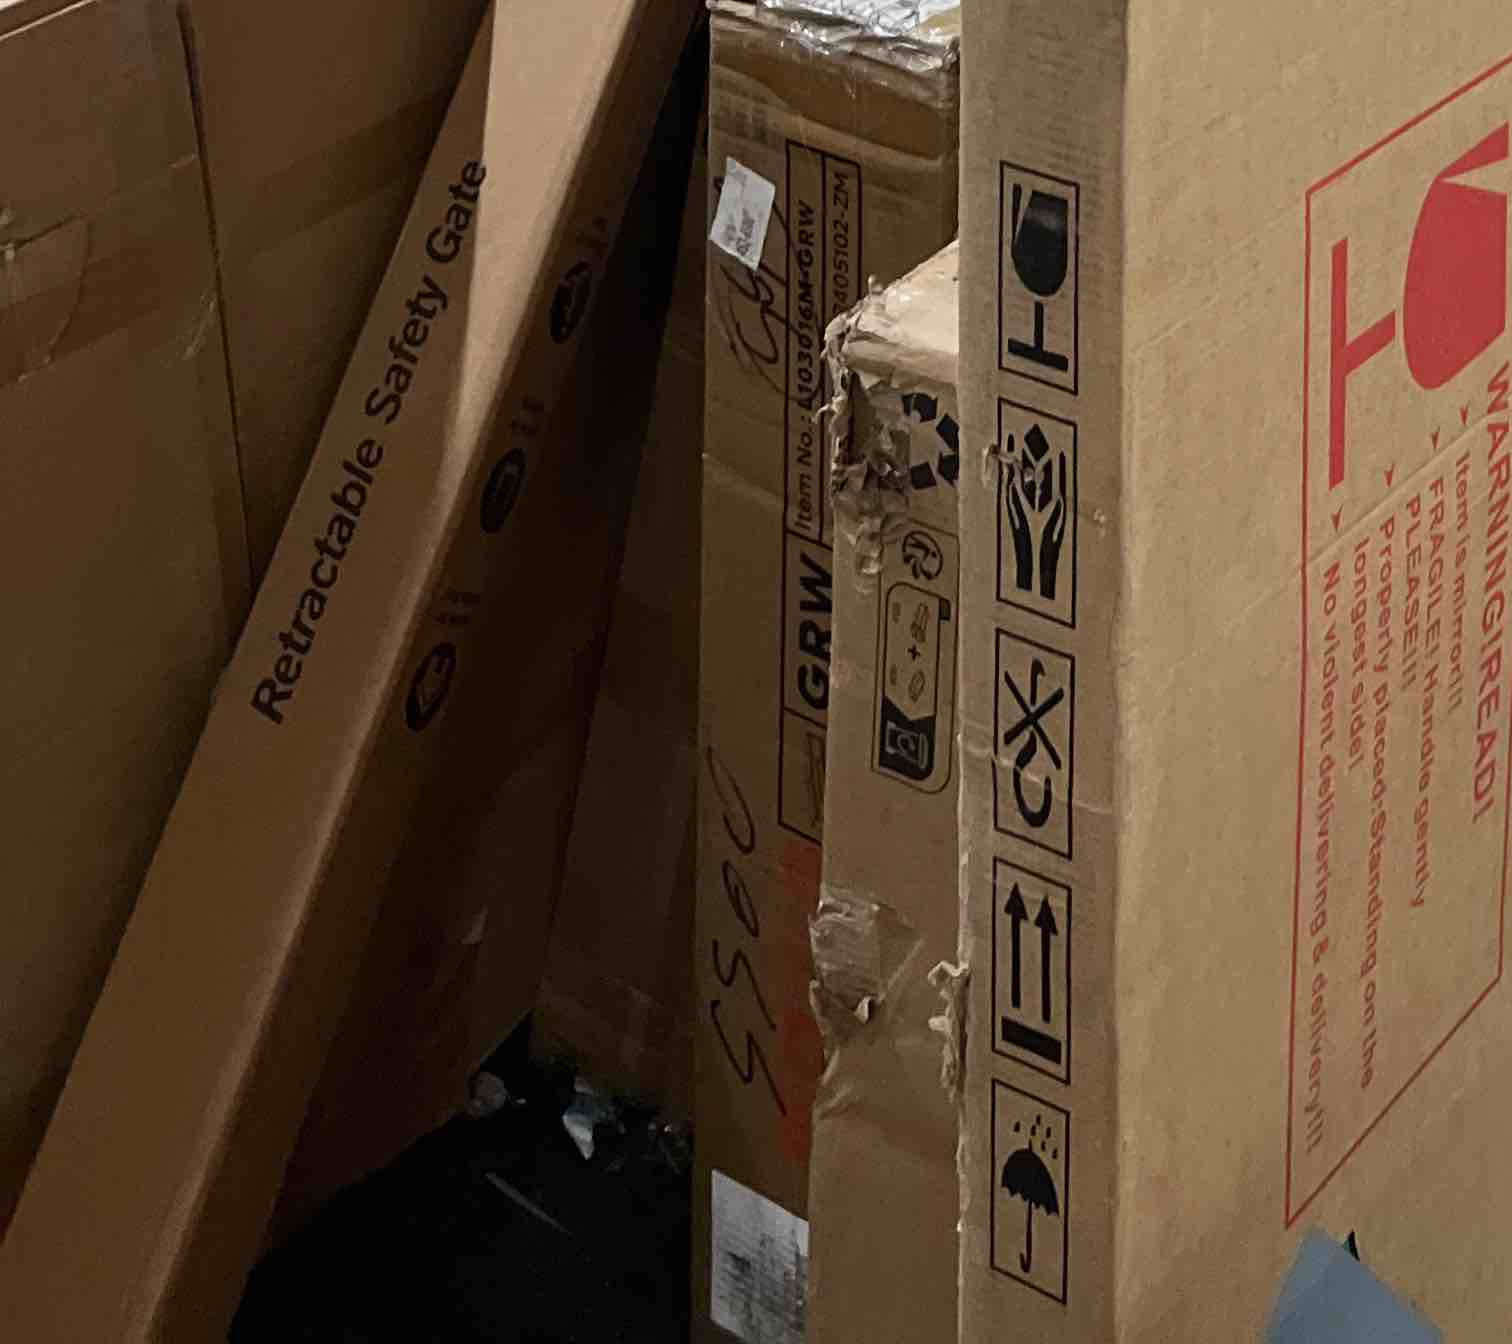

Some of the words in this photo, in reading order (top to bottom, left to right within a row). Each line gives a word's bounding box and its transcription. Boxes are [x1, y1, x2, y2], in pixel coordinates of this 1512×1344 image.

[251, 439, 382, 723] Retractable
[366, 278, 449, 424] Safety
[426, 160, 486, 263] Gate
[1453, 453, 1470, 531] Item
[796, 472, 813, 530] Item
[1454, 536, 1469, 565] is
[798, 553, 833, 710] GRW
[1321, 563, 1339, 616] No
[1349, 539, 1369, 677] longest
[1373, 519, 1394, 677] Properly
[1320, 620, 1340, 746] violent
[1418, 665, 1439, 789] Handle
[1310, 752, 1335, 936] delivering
[1409, 796, 1431, 909] gently
[1360, 1031, 1376, 1090] the
[1362, 980, 1376, 1024] on
